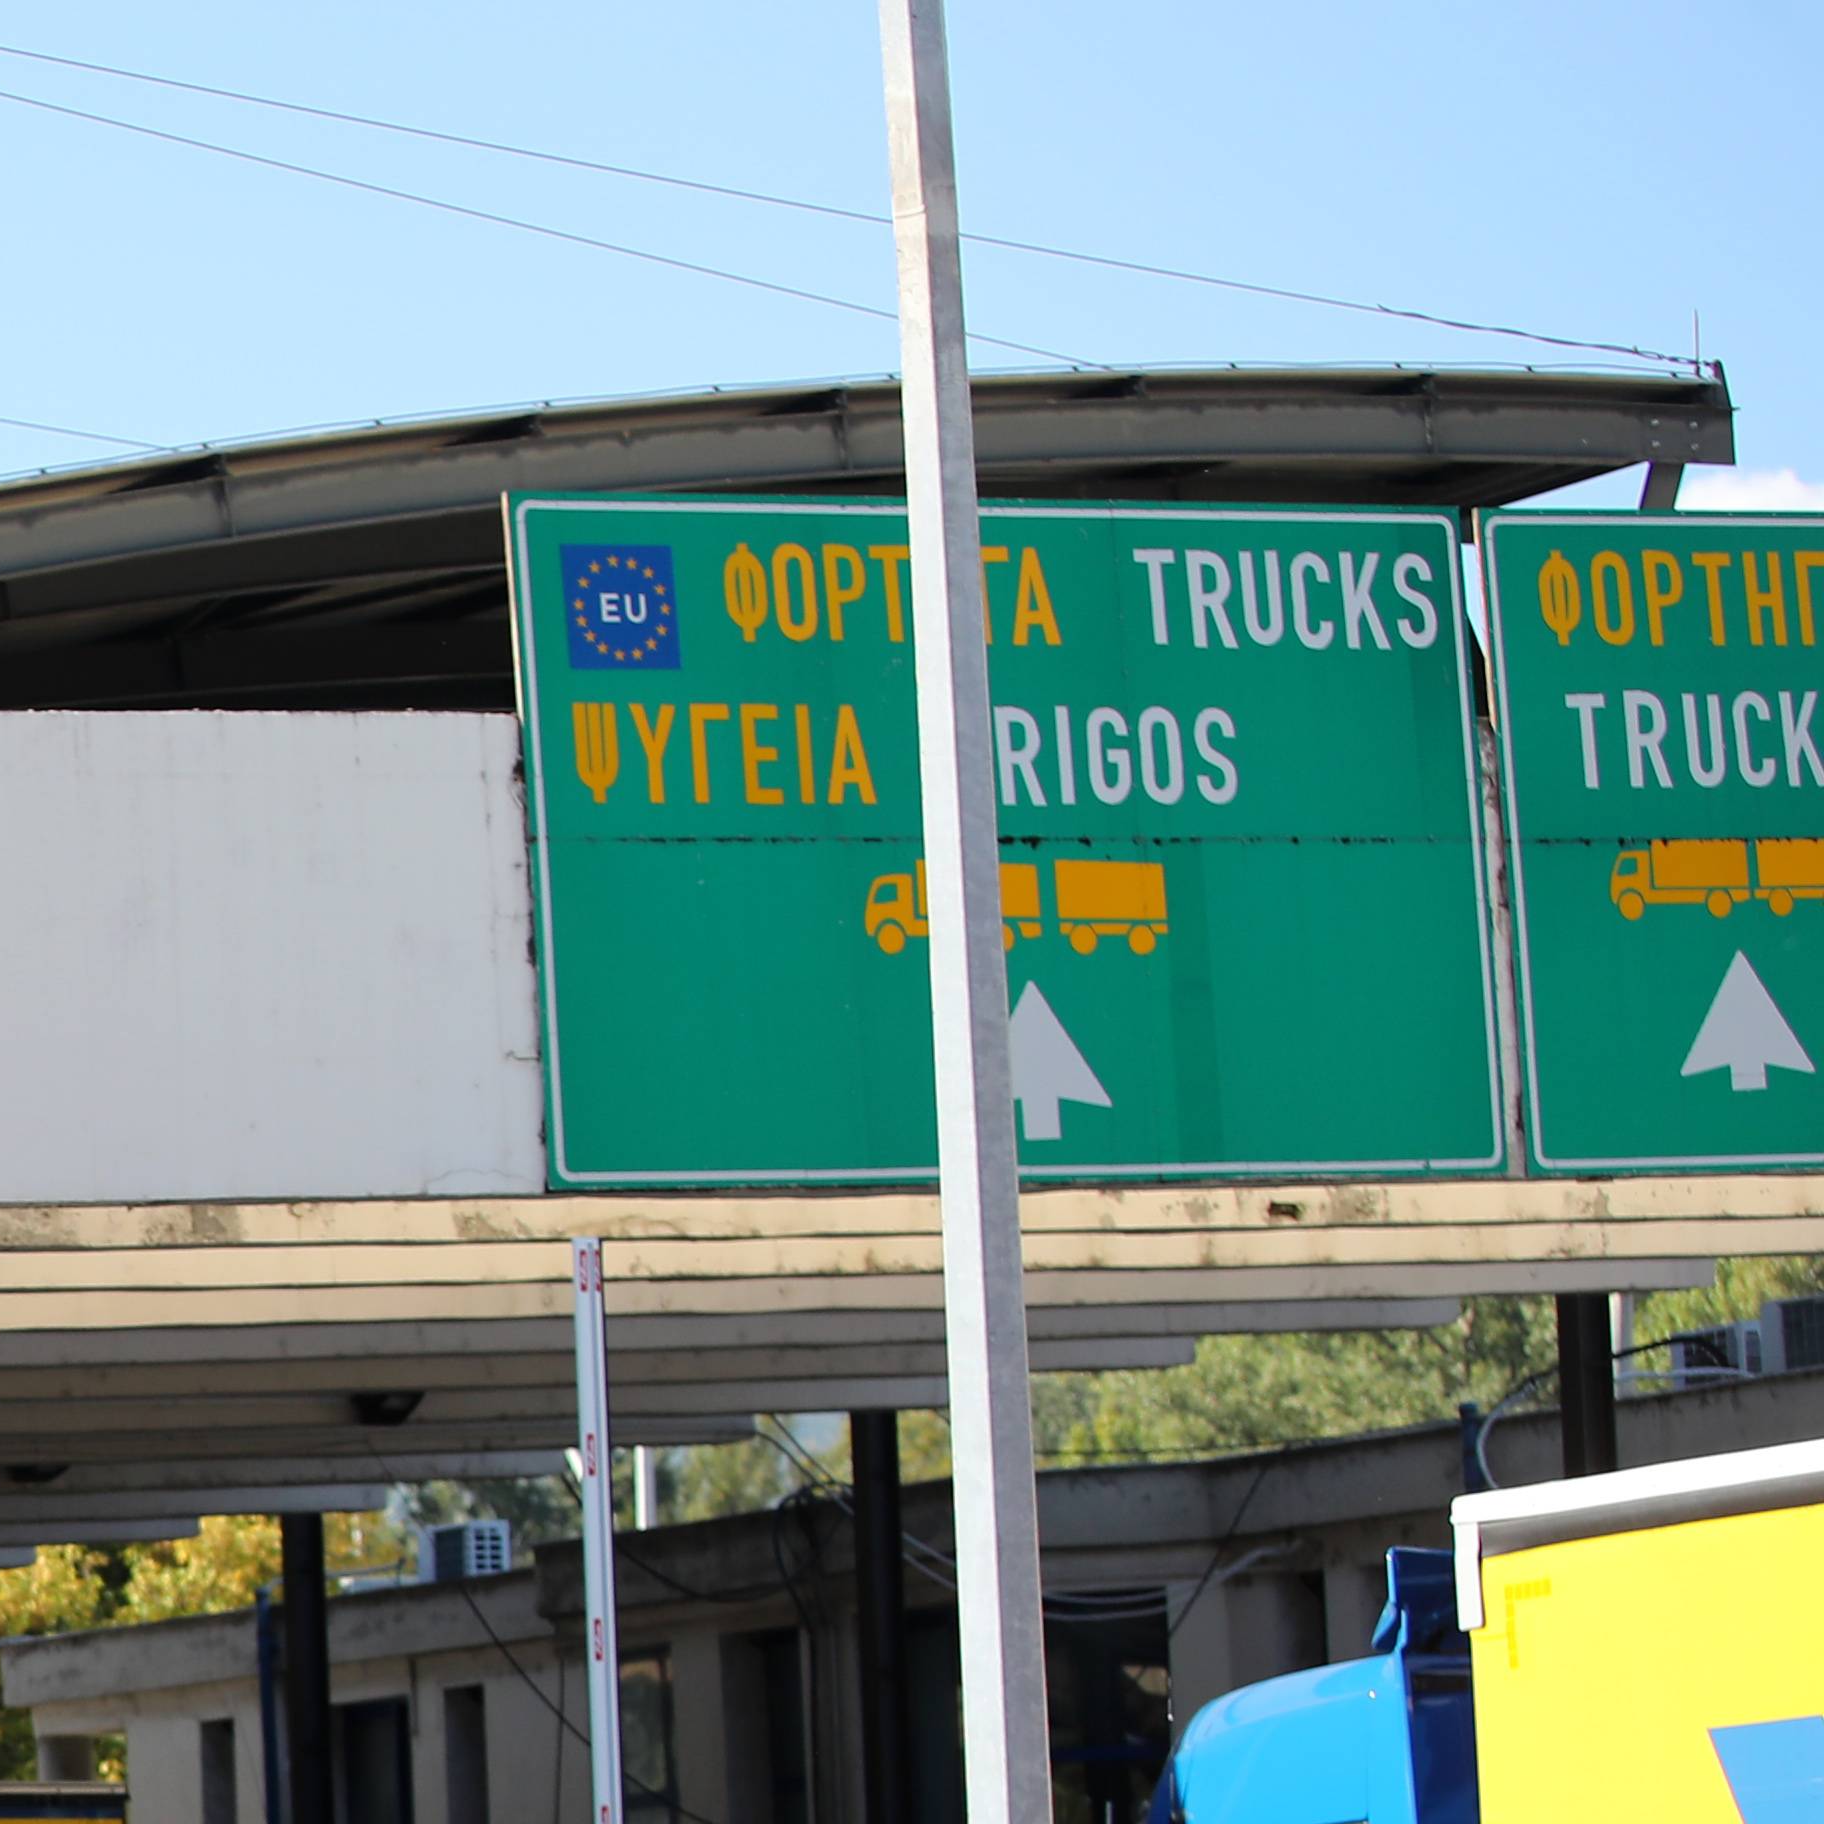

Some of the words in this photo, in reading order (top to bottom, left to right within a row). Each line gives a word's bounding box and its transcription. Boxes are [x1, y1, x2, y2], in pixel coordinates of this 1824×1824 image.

[600, 592, 648, 624] EU
[724, 543, 1062, 646] ΦΟΡΤΓΑ
[1133, 548, 1438, 650] TRUCKS
[572, 702, 878, 806] ΨΥΓΕΙΑ
[994, 706, 1238, 807] RIGOS
[1565, 689, 1824, 789] TRUCK
